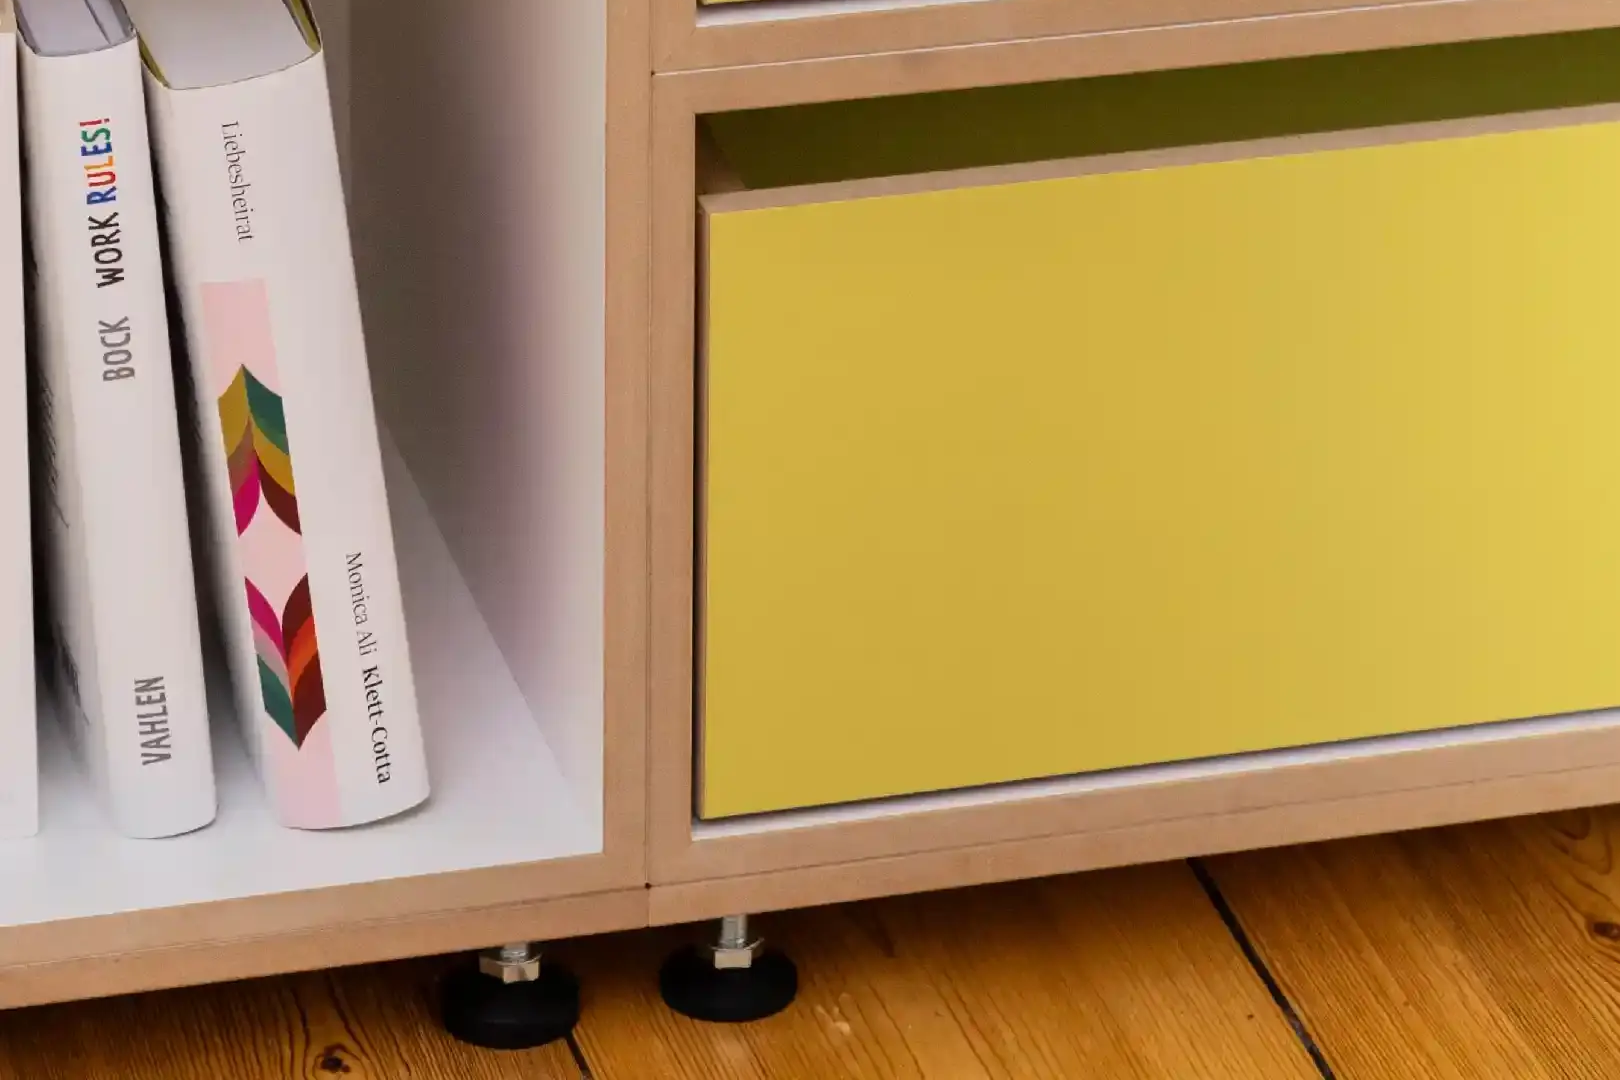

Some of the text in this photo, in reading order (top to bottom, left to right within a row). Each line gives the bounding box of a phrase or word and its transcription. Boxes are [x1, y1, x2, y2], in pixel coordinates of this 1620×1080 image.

[78, 117, 136, 382] BOCK WORK RULES!
[221, 120, 254, 243] Liebesheirat
[134, 675, 172, 766] VAHLEN
[345, 551, 391, 784] Monica Ali Klett-Cotta
